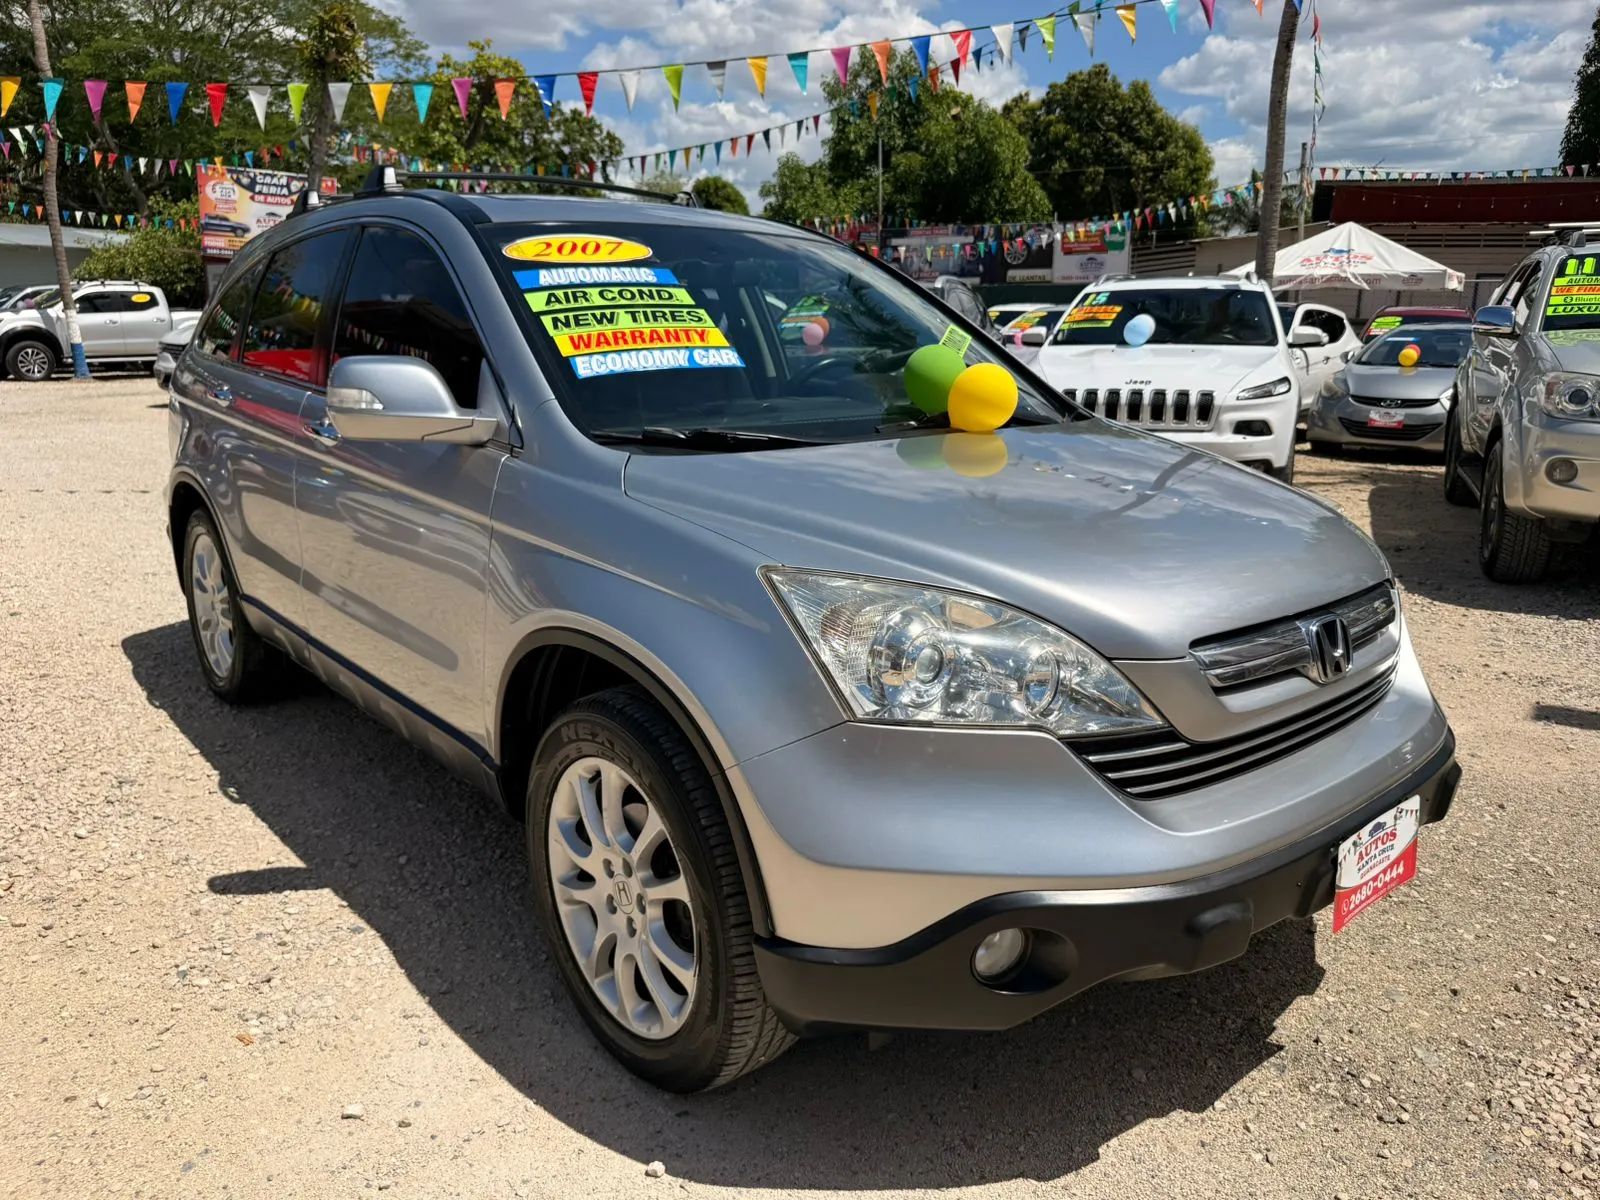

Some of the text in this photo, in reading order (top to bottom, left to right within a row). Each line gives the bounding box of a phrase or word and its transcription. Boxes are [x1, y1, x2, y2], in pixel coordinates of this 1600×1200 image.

[255, 175, 288, 185] GRAN
[255, 184, 289, 195] FERIA
[266, 196, 292, 205] AUTOS
[532, 240, 624, 258] 2007
[1565, 257, 1596, 274] 11
[538, 267, 657, 287] AUTOMATIC
[545, 288, 681, 307] AIR COND.
[1551, 305, 1600, 313] LUXU
[552, 309, 705, 331] NEW TIRES
[568, 328, 710, 352] WARRANTY
[576, 347, 741, 376] ECONOMY CAR
[1356, 827, 1398, 867] AUTOS
[1357, 843, 1395, 873] SANTA CRUZ
[1349, 859, 1405, 911] 2680-0444
